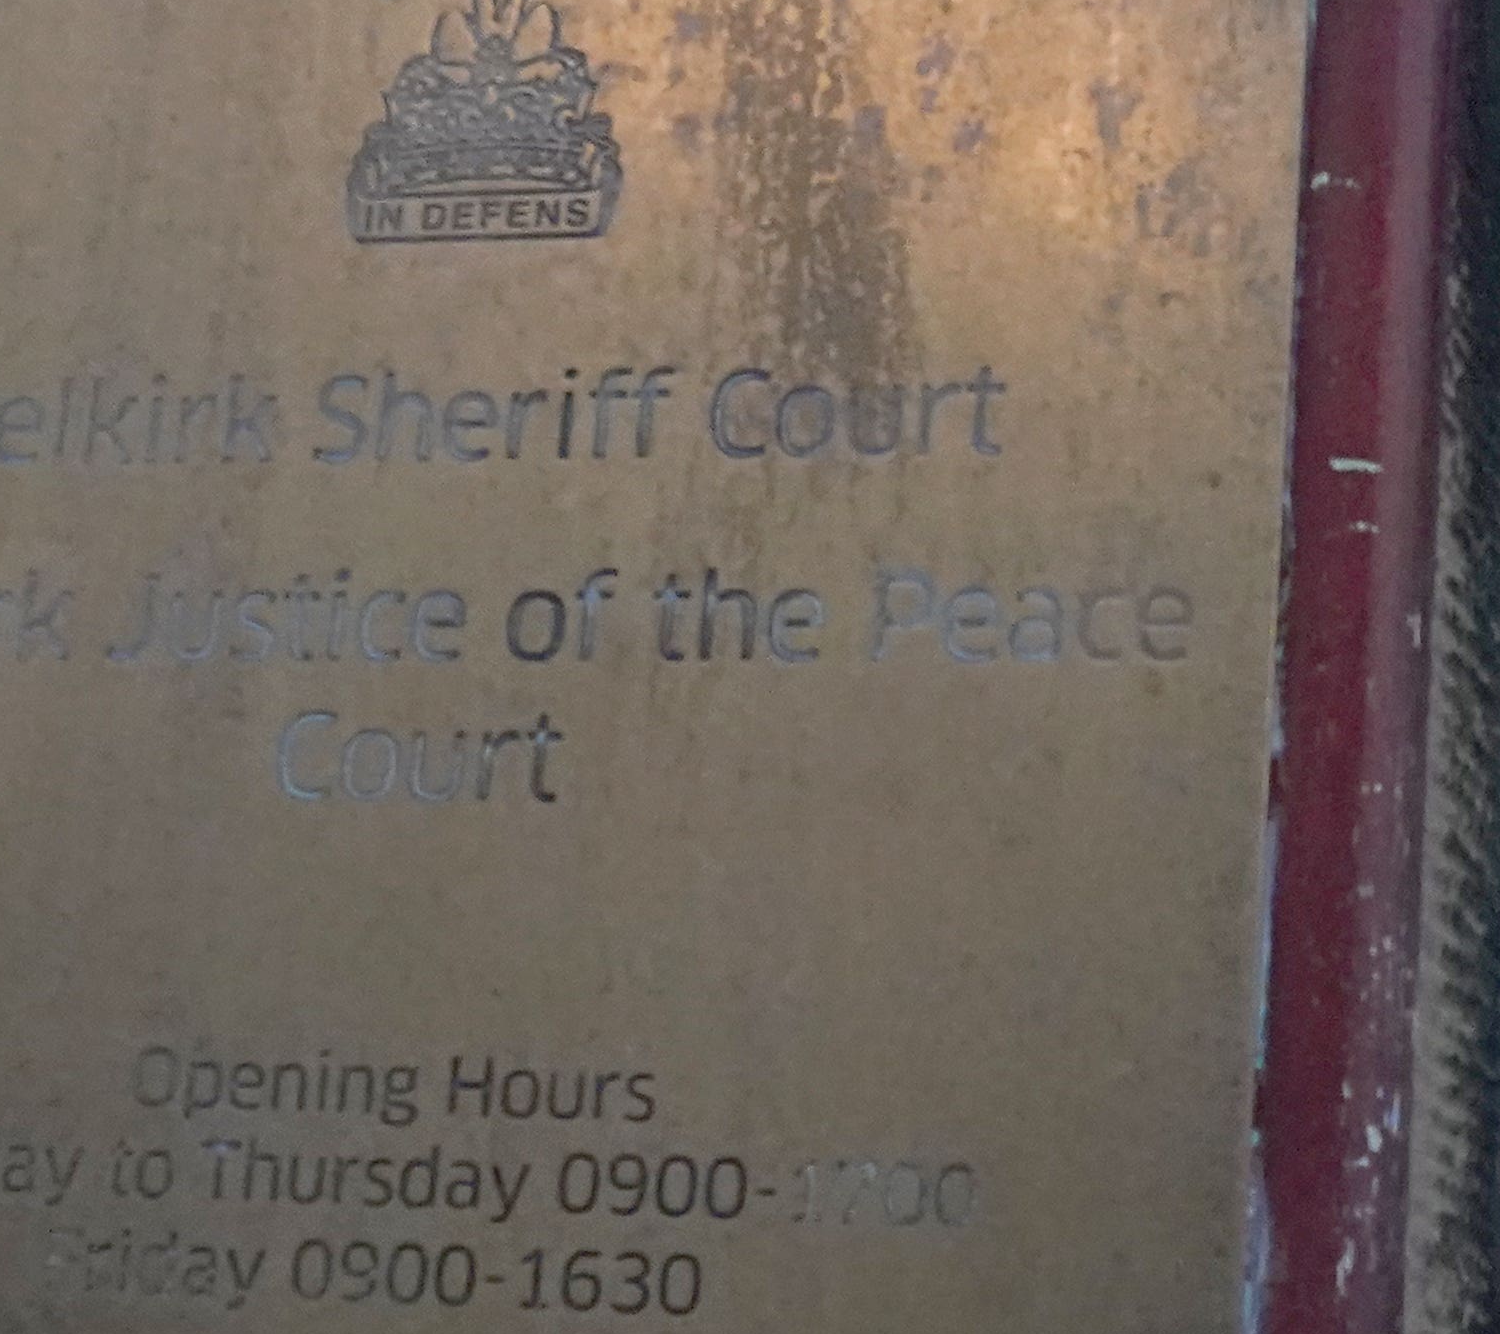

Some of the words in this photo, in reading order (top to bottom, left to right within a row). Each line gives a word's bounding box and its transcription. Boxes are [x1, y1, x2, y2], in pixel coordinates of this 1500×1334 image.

[364, 204, 403, 233] IN
[420, 198, 591, 231] DEFENS
[311, 367, 678, 463] Sheriff
[708, 365, 1007, 460] Court
[104, 568, 468, 662] Justice
[505, 566, 620, 664] of
[653, 566, 824, 664] the
[868, 567, 1196, 664] Peace
[277, 710, 564, 804] Court
[132, 1044, 421, 1126] Opening
[446, 1054, 657, 1123] Hours
[111, 1139, 175, 1200] to
[199, 1138, 533, 1225] Thursday
[290, 1237, 702, 1318] 0900-1630
